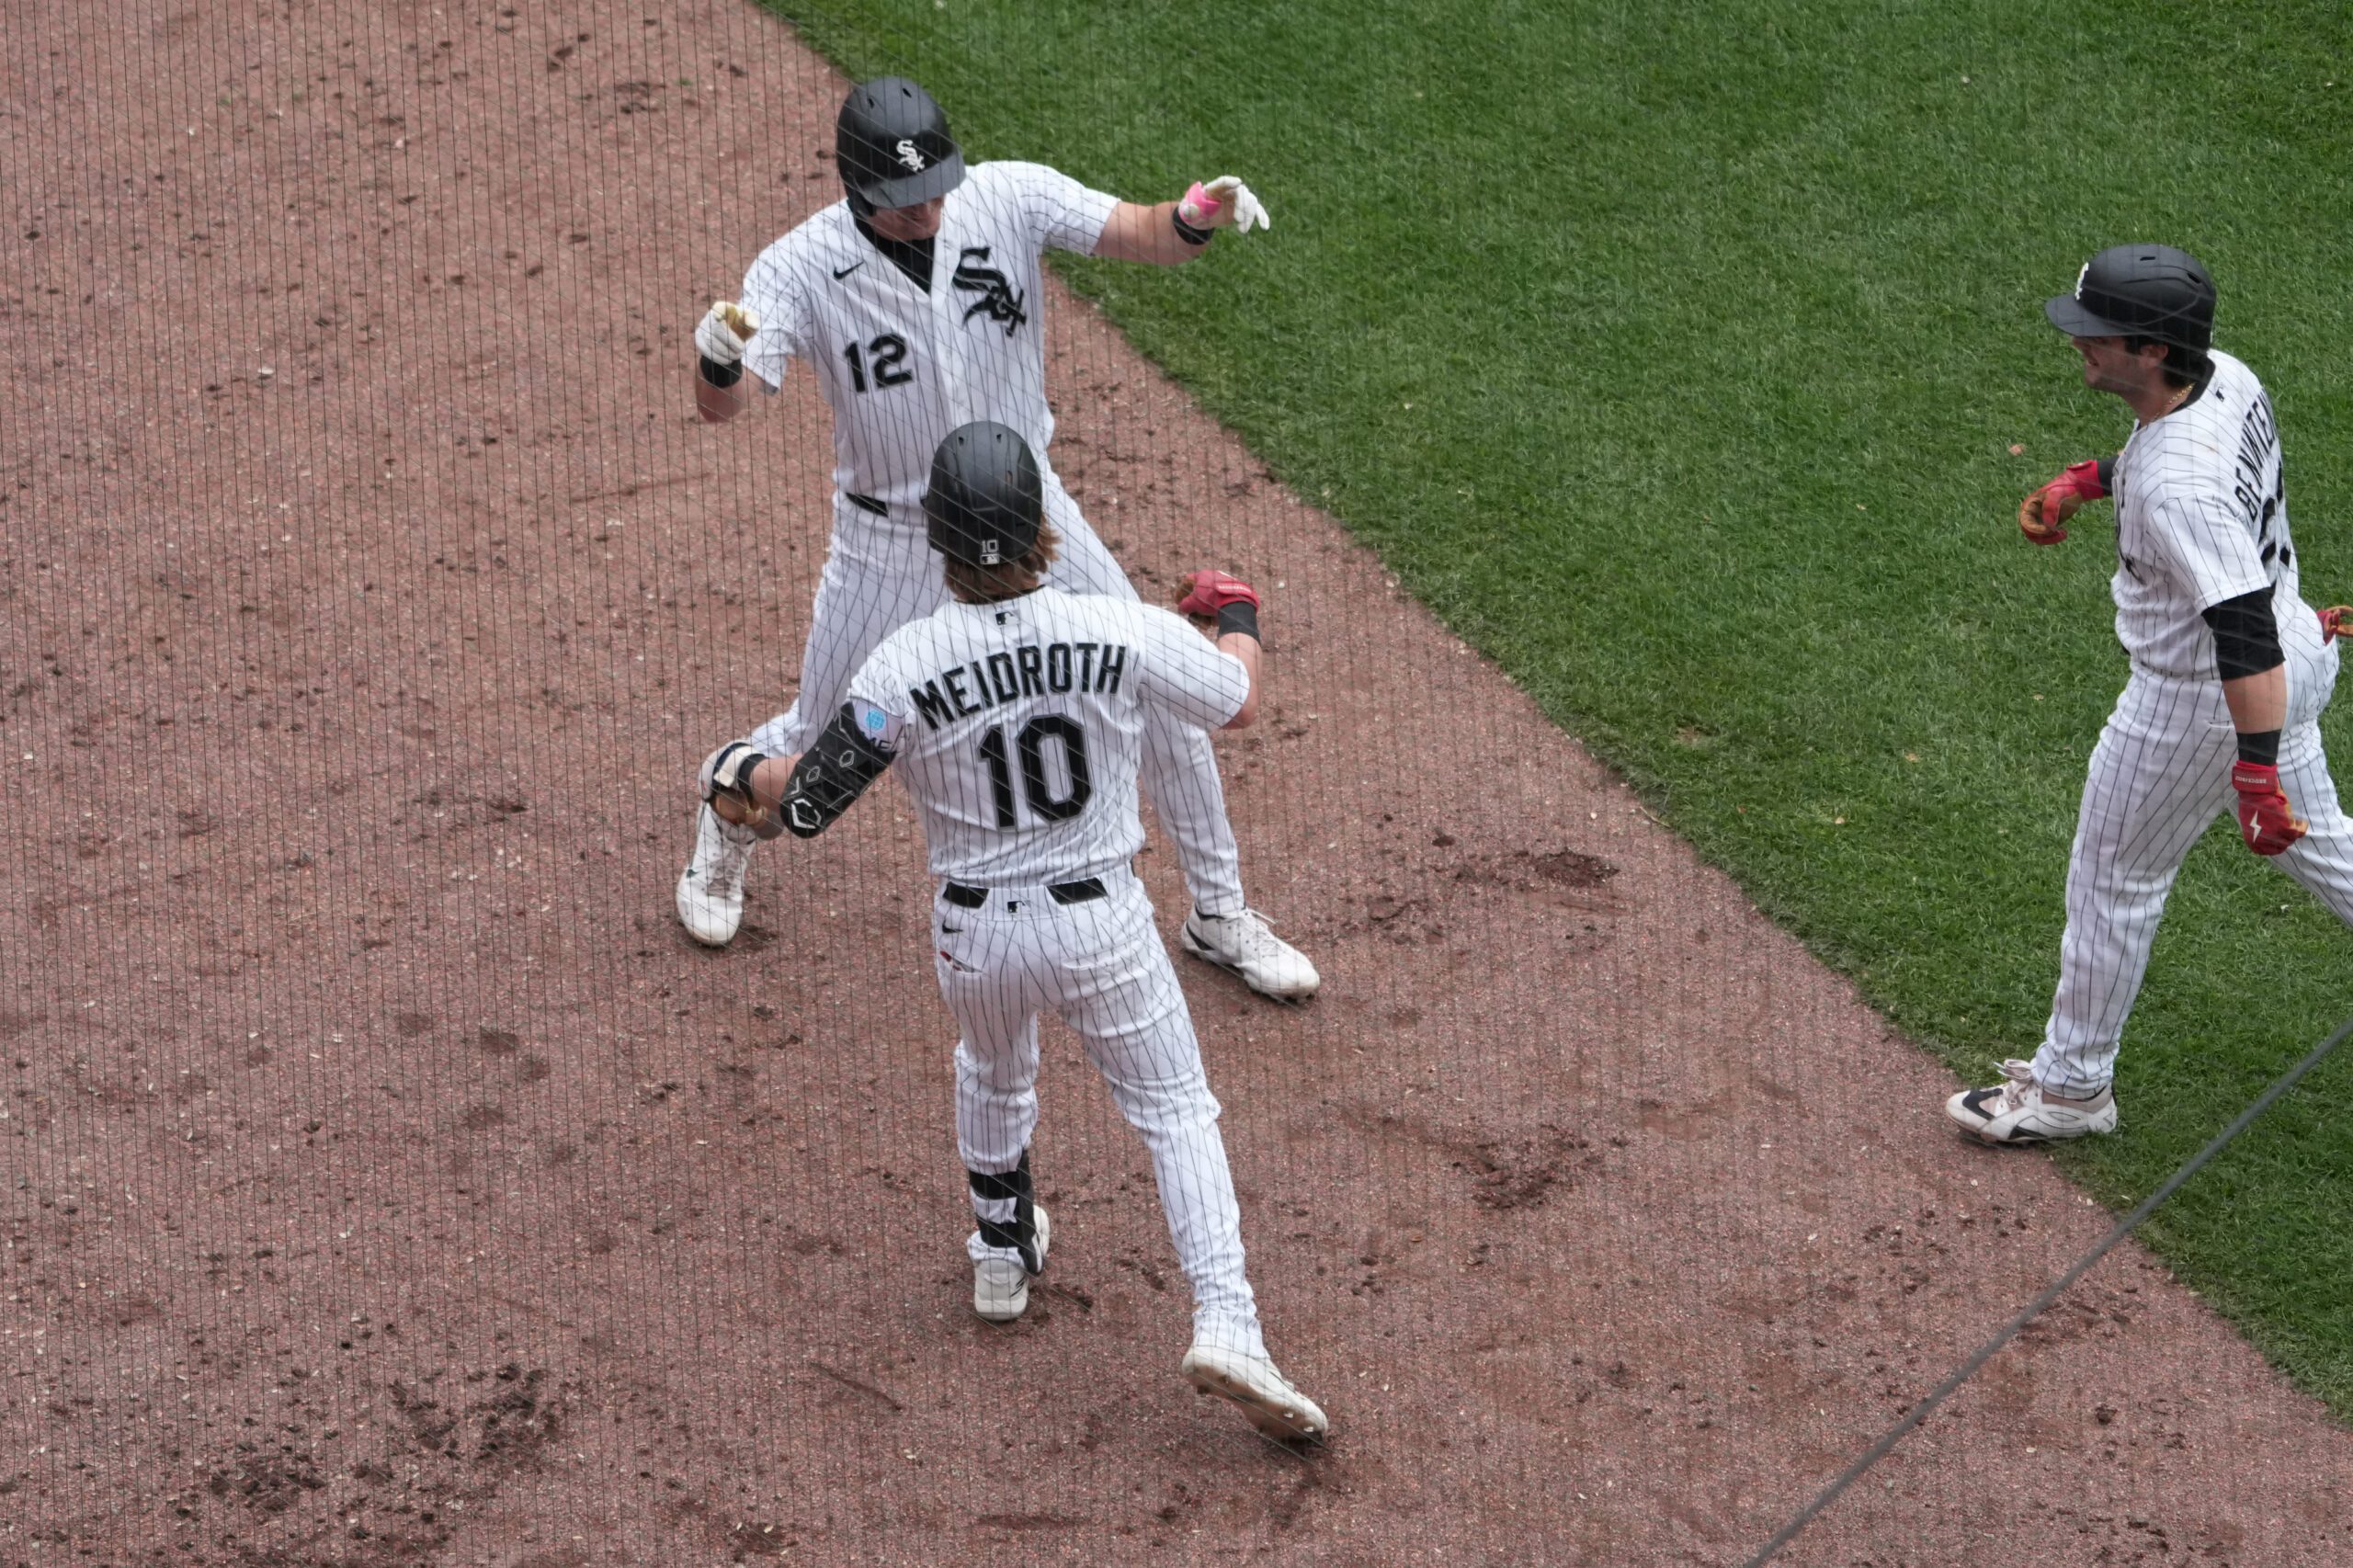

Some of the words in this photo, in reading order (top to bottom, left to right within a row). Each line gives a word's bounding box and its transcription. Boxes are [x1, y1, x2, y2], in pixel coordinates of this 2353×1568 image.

[844, 332, 914, 393] 12
[981, 539, 1000, 553] 10
[909, 642, 1127, 732] MEIDROTH
[977, 712, 1094, 832] 10
